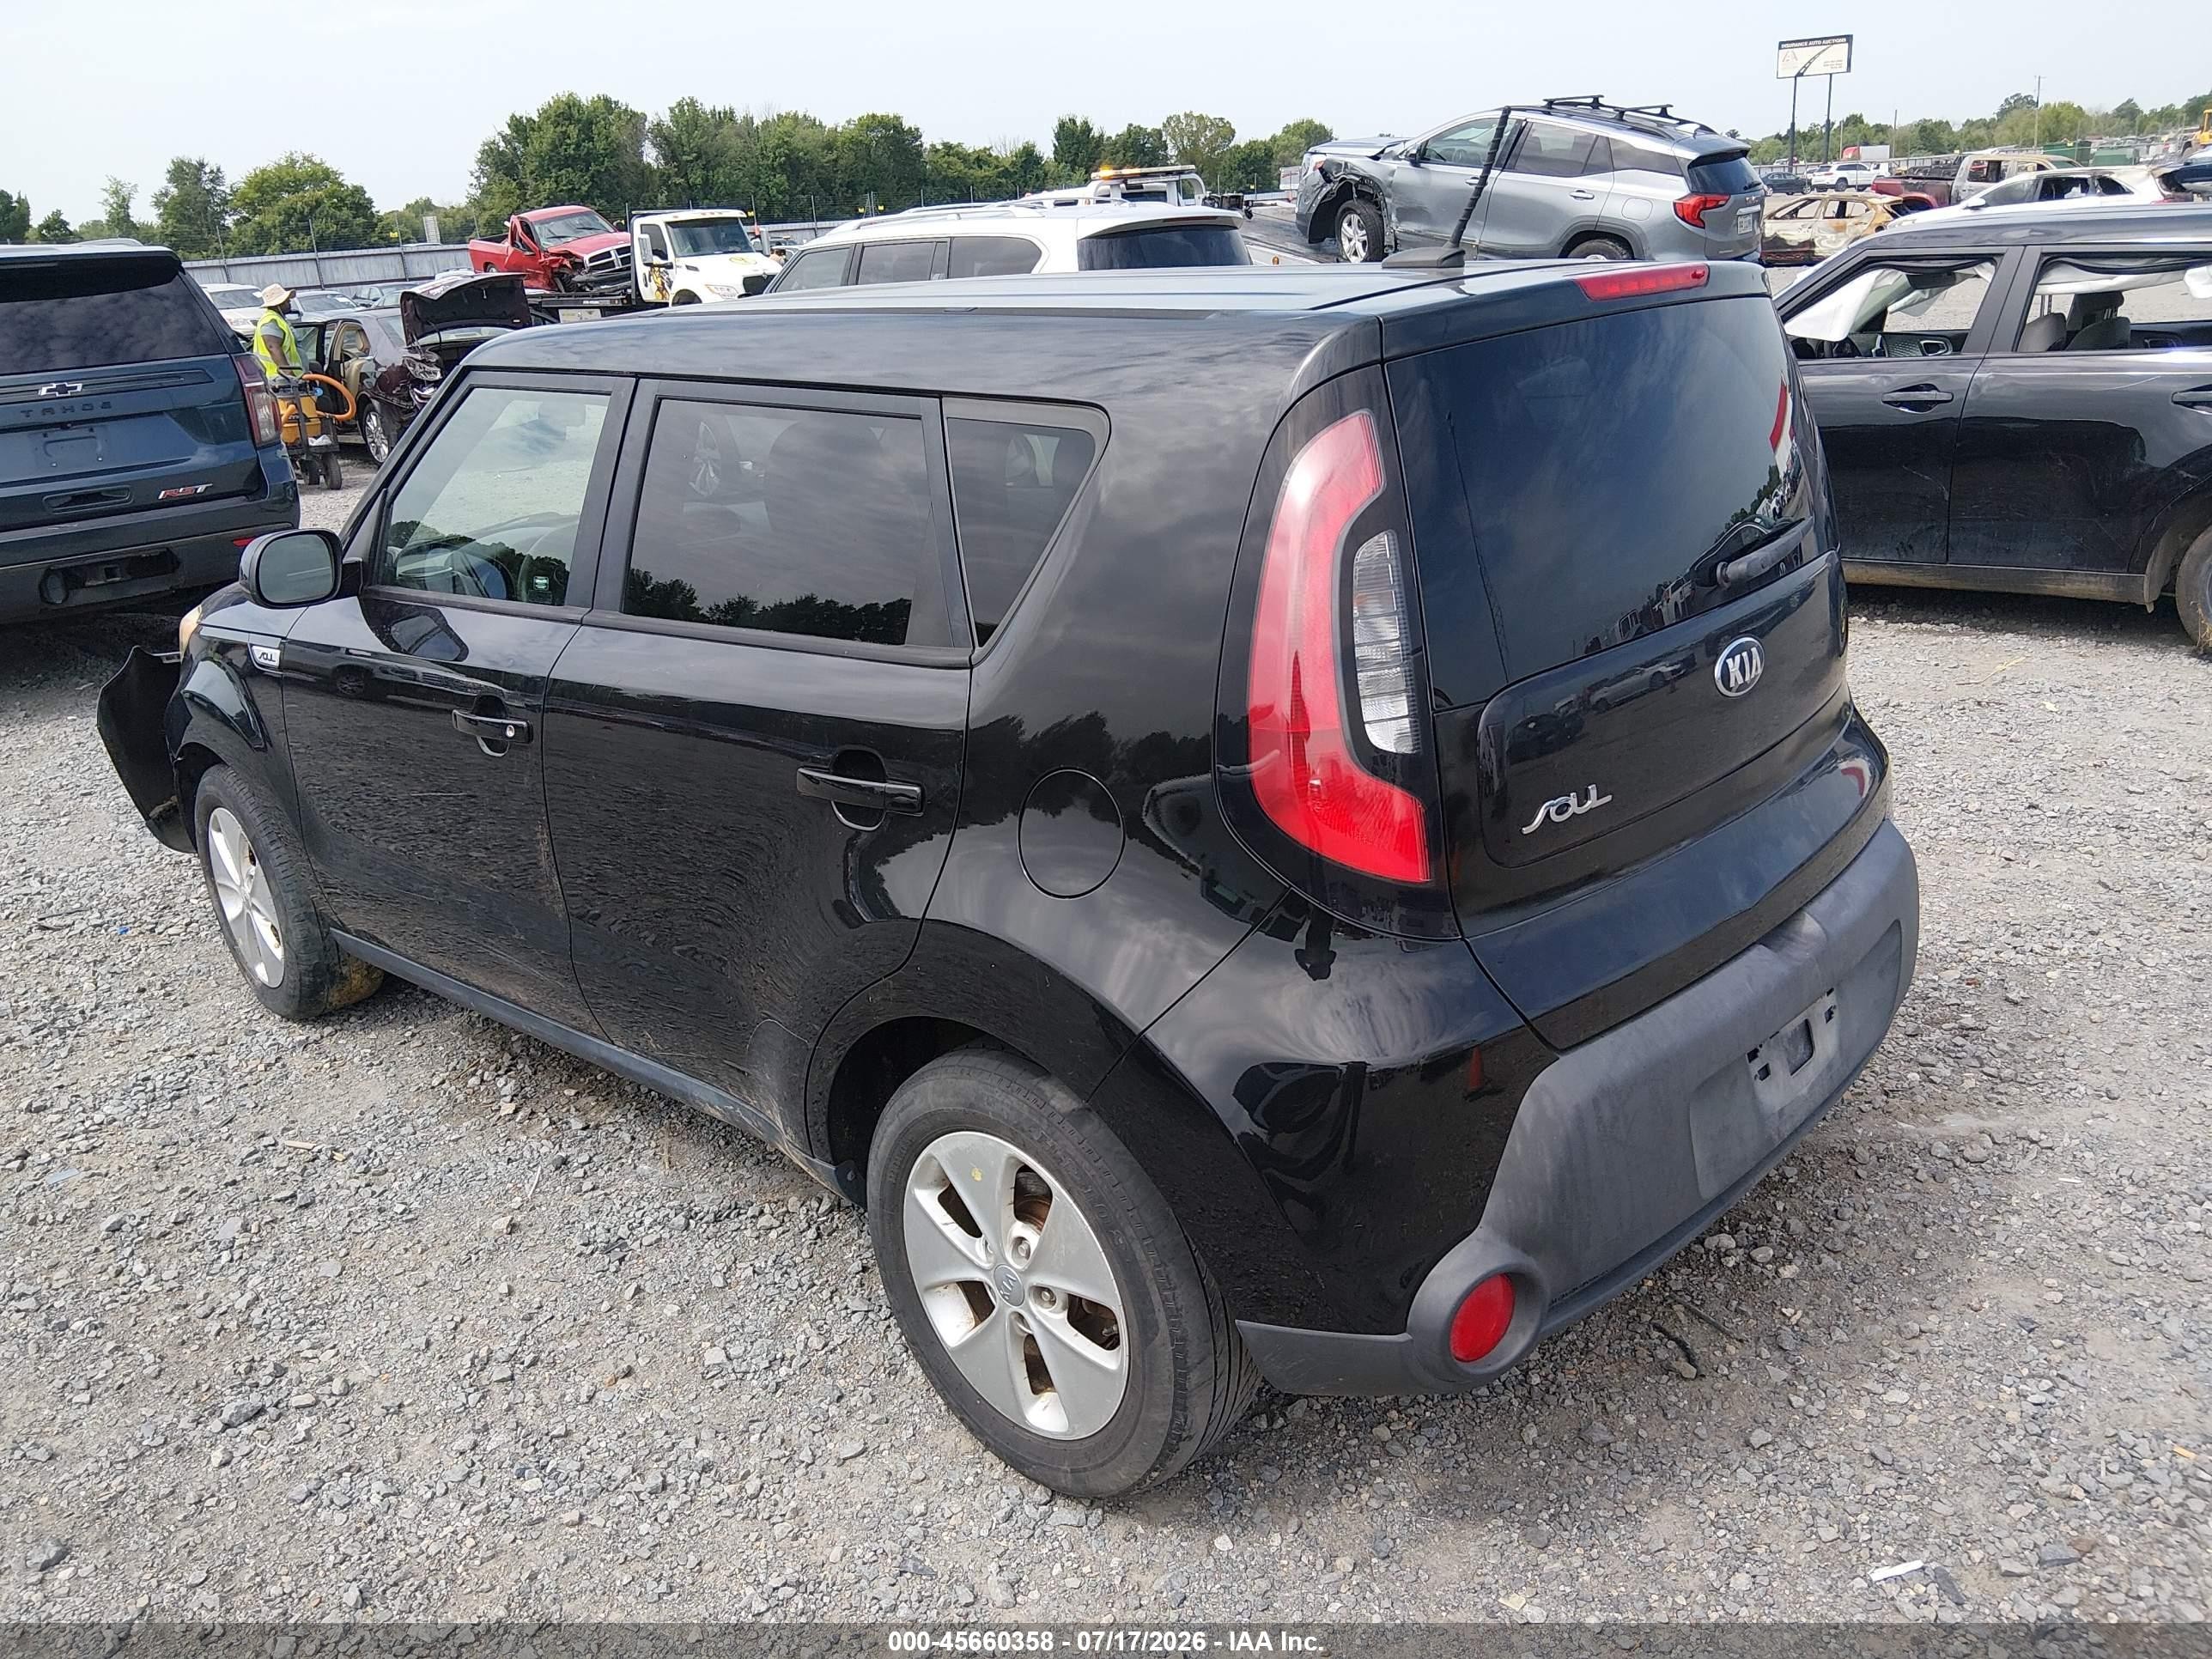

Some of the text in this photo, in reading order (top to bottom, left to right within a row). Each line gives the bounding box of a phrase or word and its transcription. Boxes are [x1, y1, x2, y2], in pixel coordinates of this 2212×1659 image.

[21, 400, 112, 418] TAHOE
[158, 483, 214, 500] RST
[1725, 646, 1762, 689] KIA
[1521, 783, 1613, 835] SOUL
